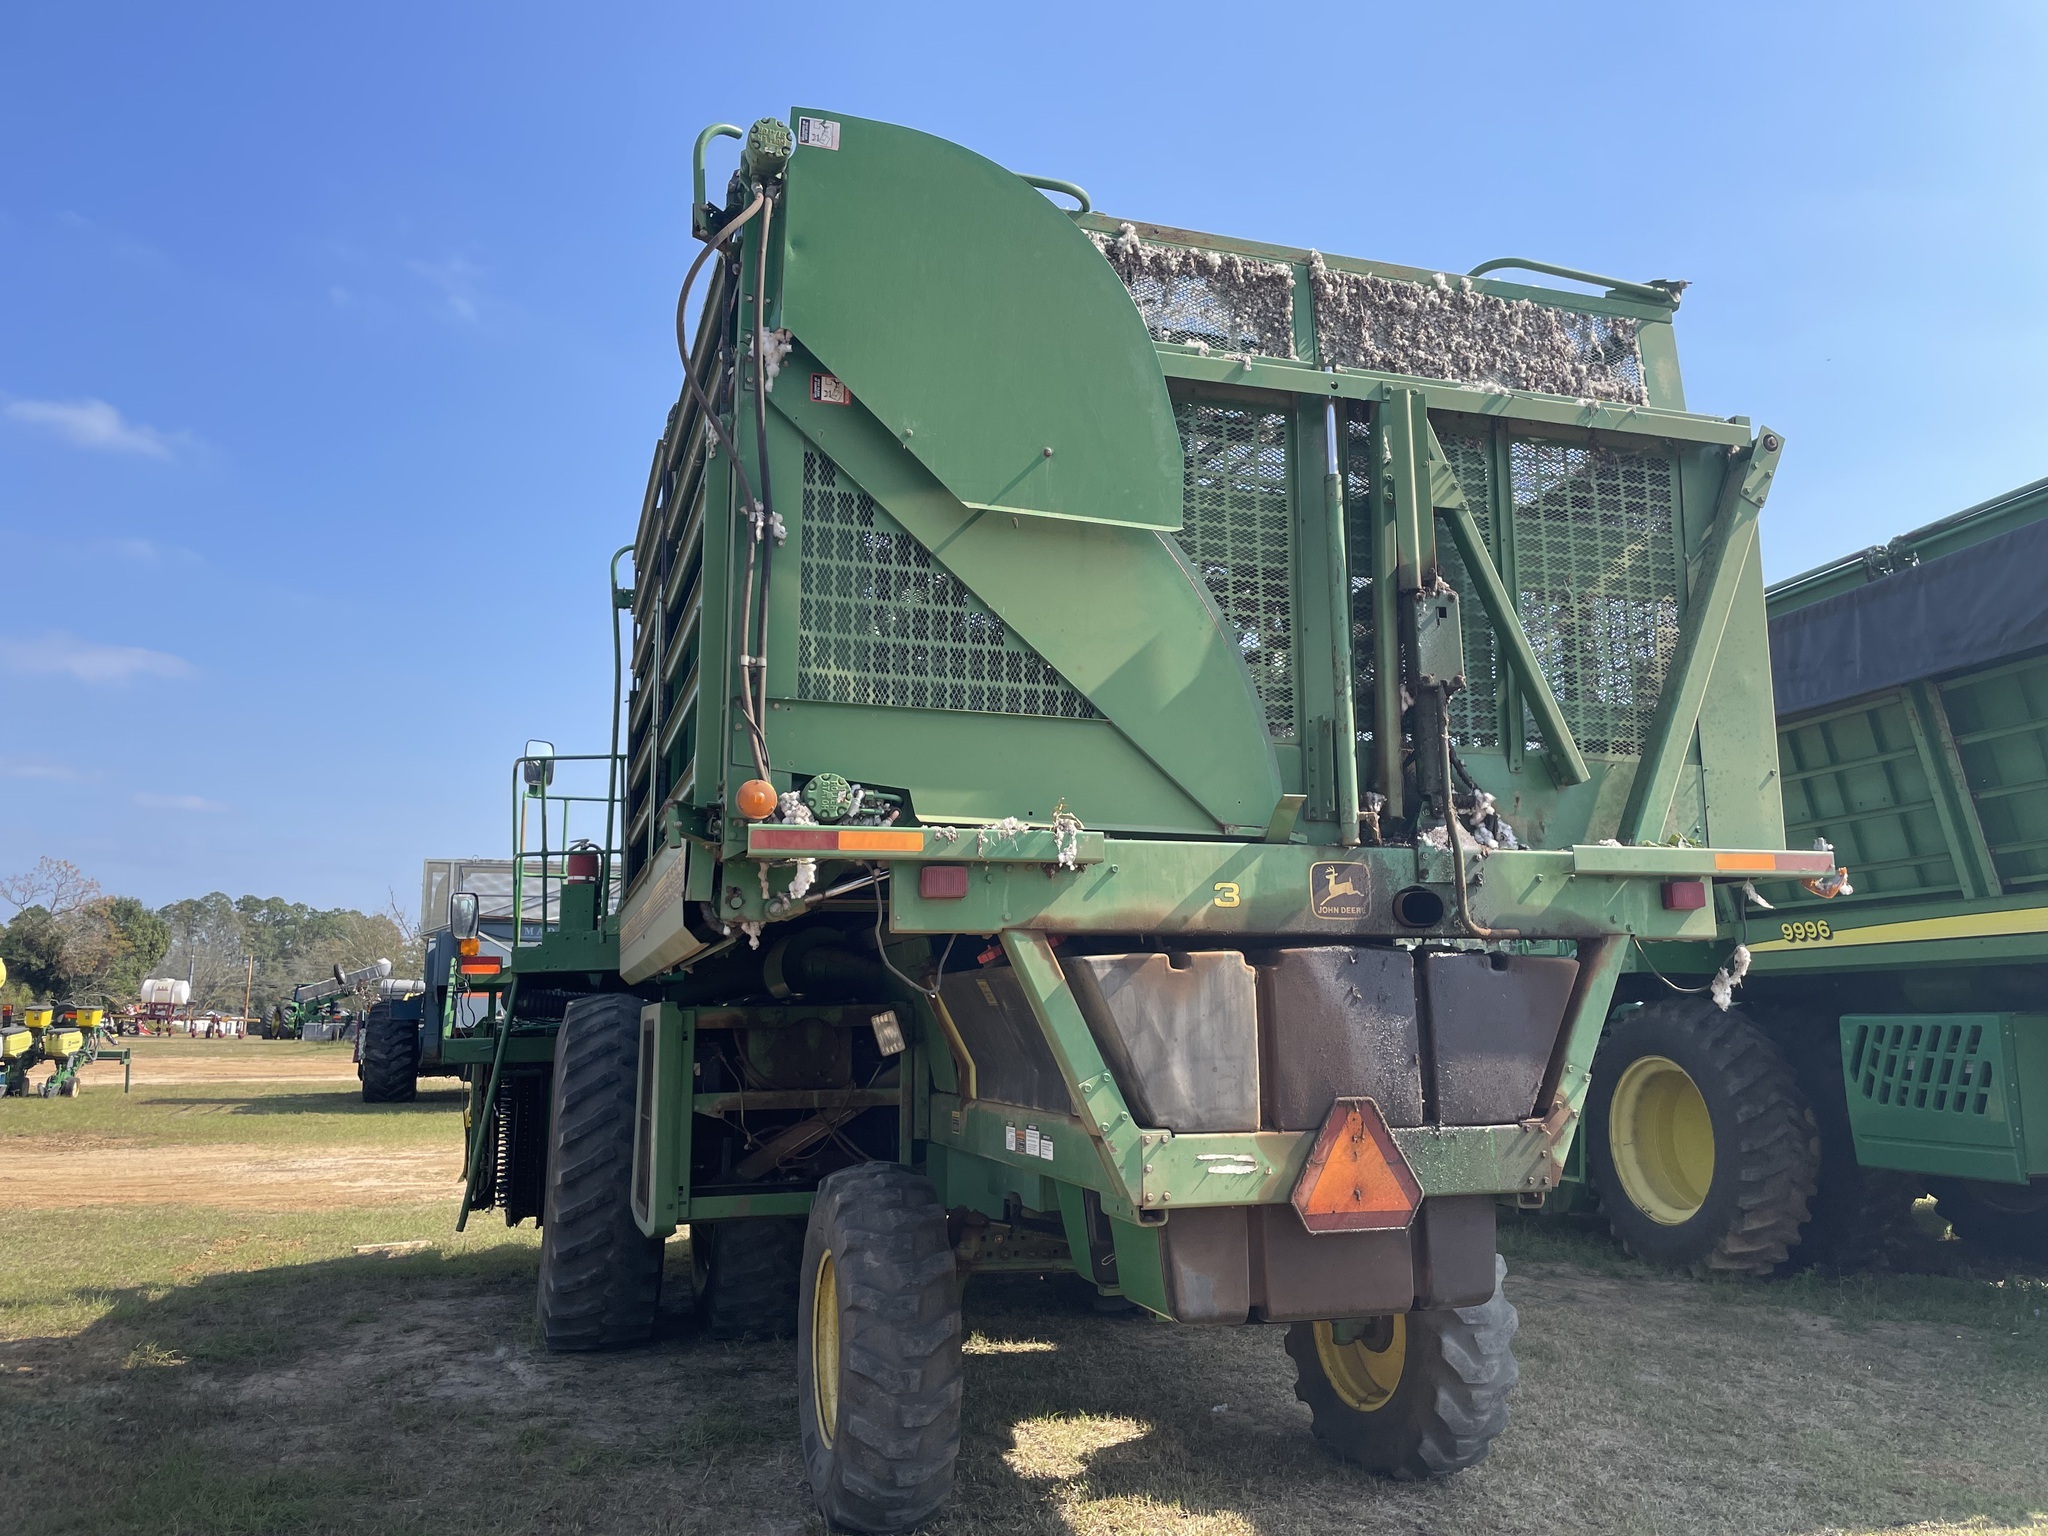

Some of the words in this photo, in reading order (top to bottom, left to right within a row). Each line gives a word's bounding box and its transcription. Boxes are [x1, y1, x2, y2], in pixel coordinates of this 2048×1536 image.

[821, 781, 830, 809] STATOR
[1213, 882, 1240, 908] 3
[1318, 906, 1339, 914] JOHN
[1340, 906, 1366, 914] DEERE
[1781, 919, 1831, 941] 9996
